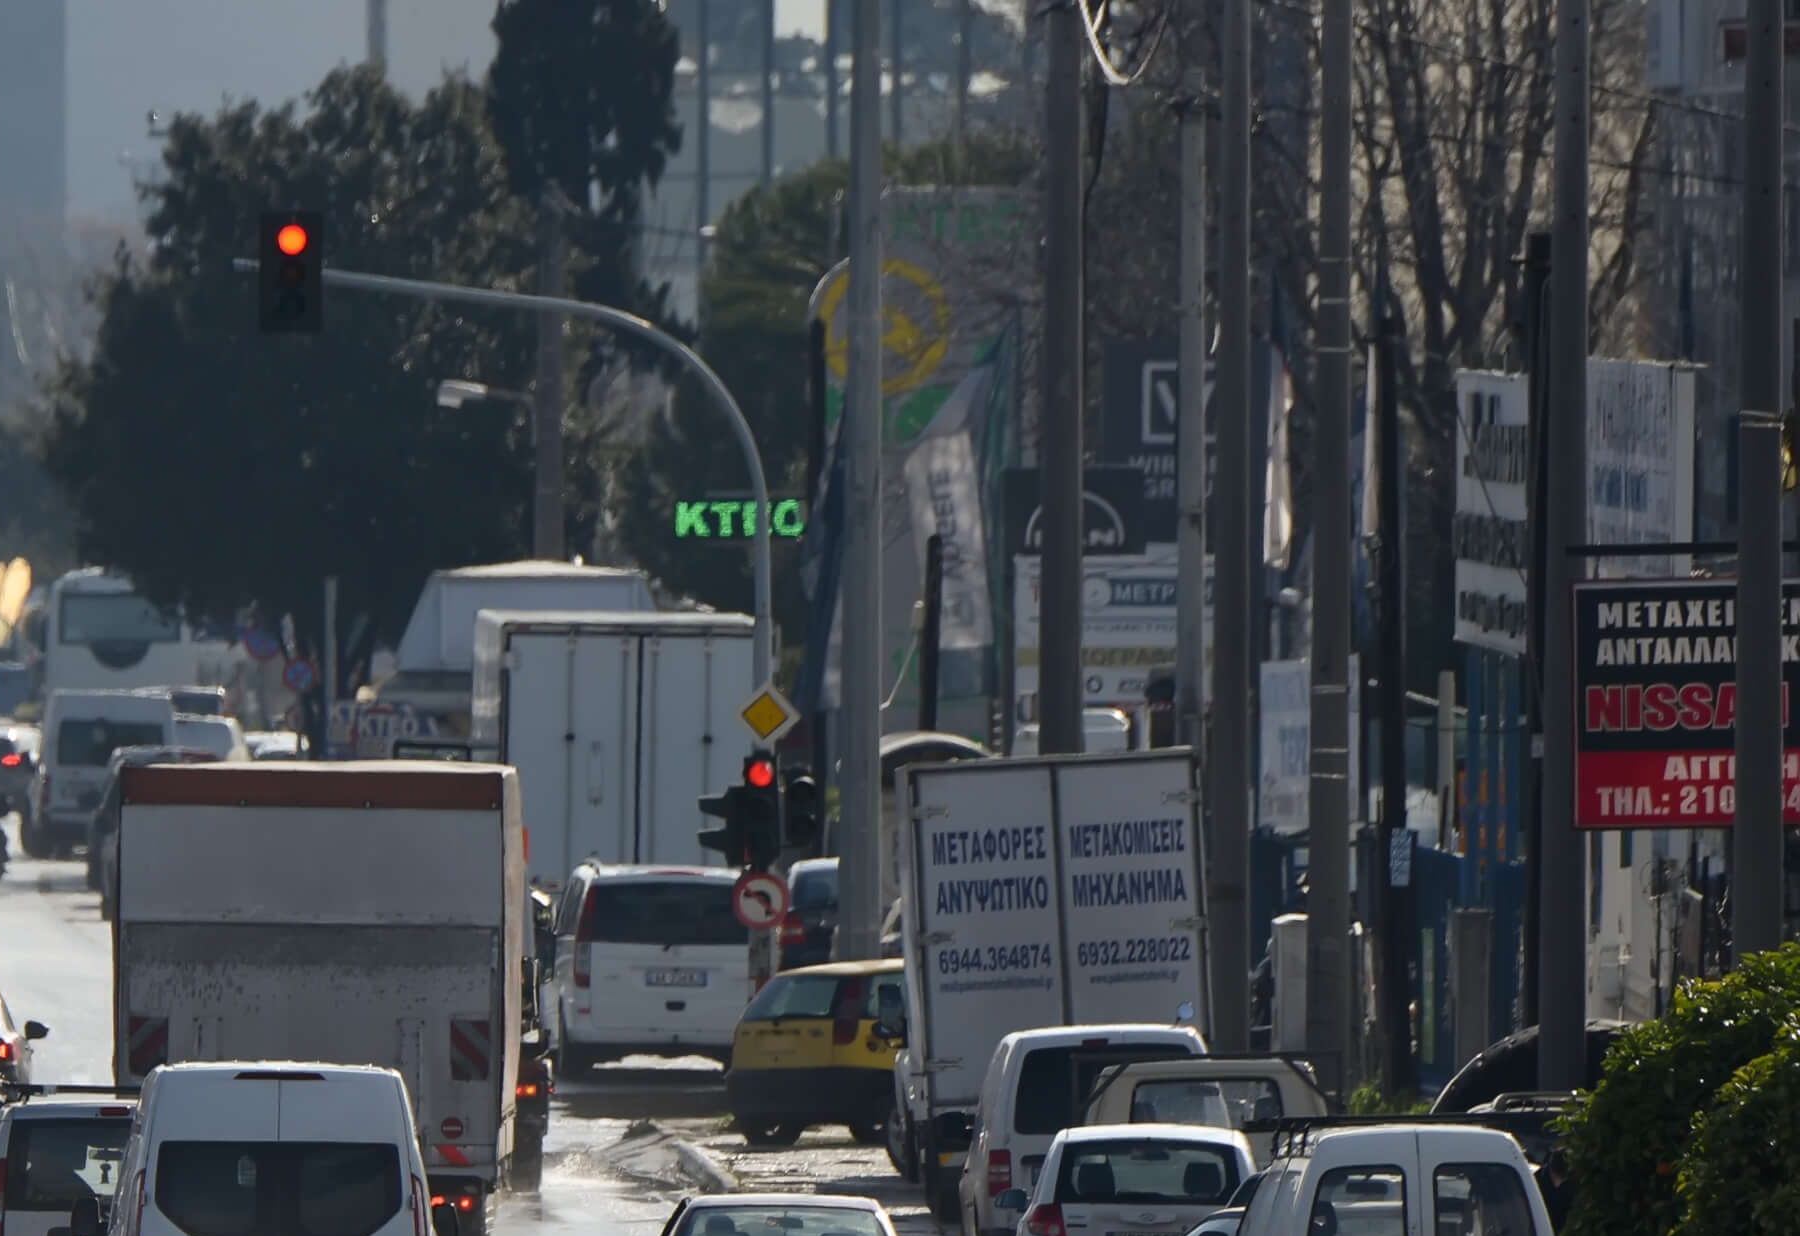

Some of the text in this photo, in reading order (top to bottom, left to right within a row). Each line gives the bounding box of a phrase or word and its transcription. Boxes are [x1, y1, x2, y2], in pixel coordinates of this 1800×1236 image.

[932, 826, 1046, 866] ΜΕΤΑΦΟΡΕΣ
[1069, 818, 1185, 859] ΜΕΤΑΚΟΜΙΣΕΙΣ
[936, 875, 1049, 915] ΑΝΥΨΩΤΙΚΟ
[1072, 868, 1187, 907] ΜΗΧΑΝΗΜΑ
[938, 944, 1052, 975] 6944.364874
[1077, 936, 1191, 967] 6932.228022
